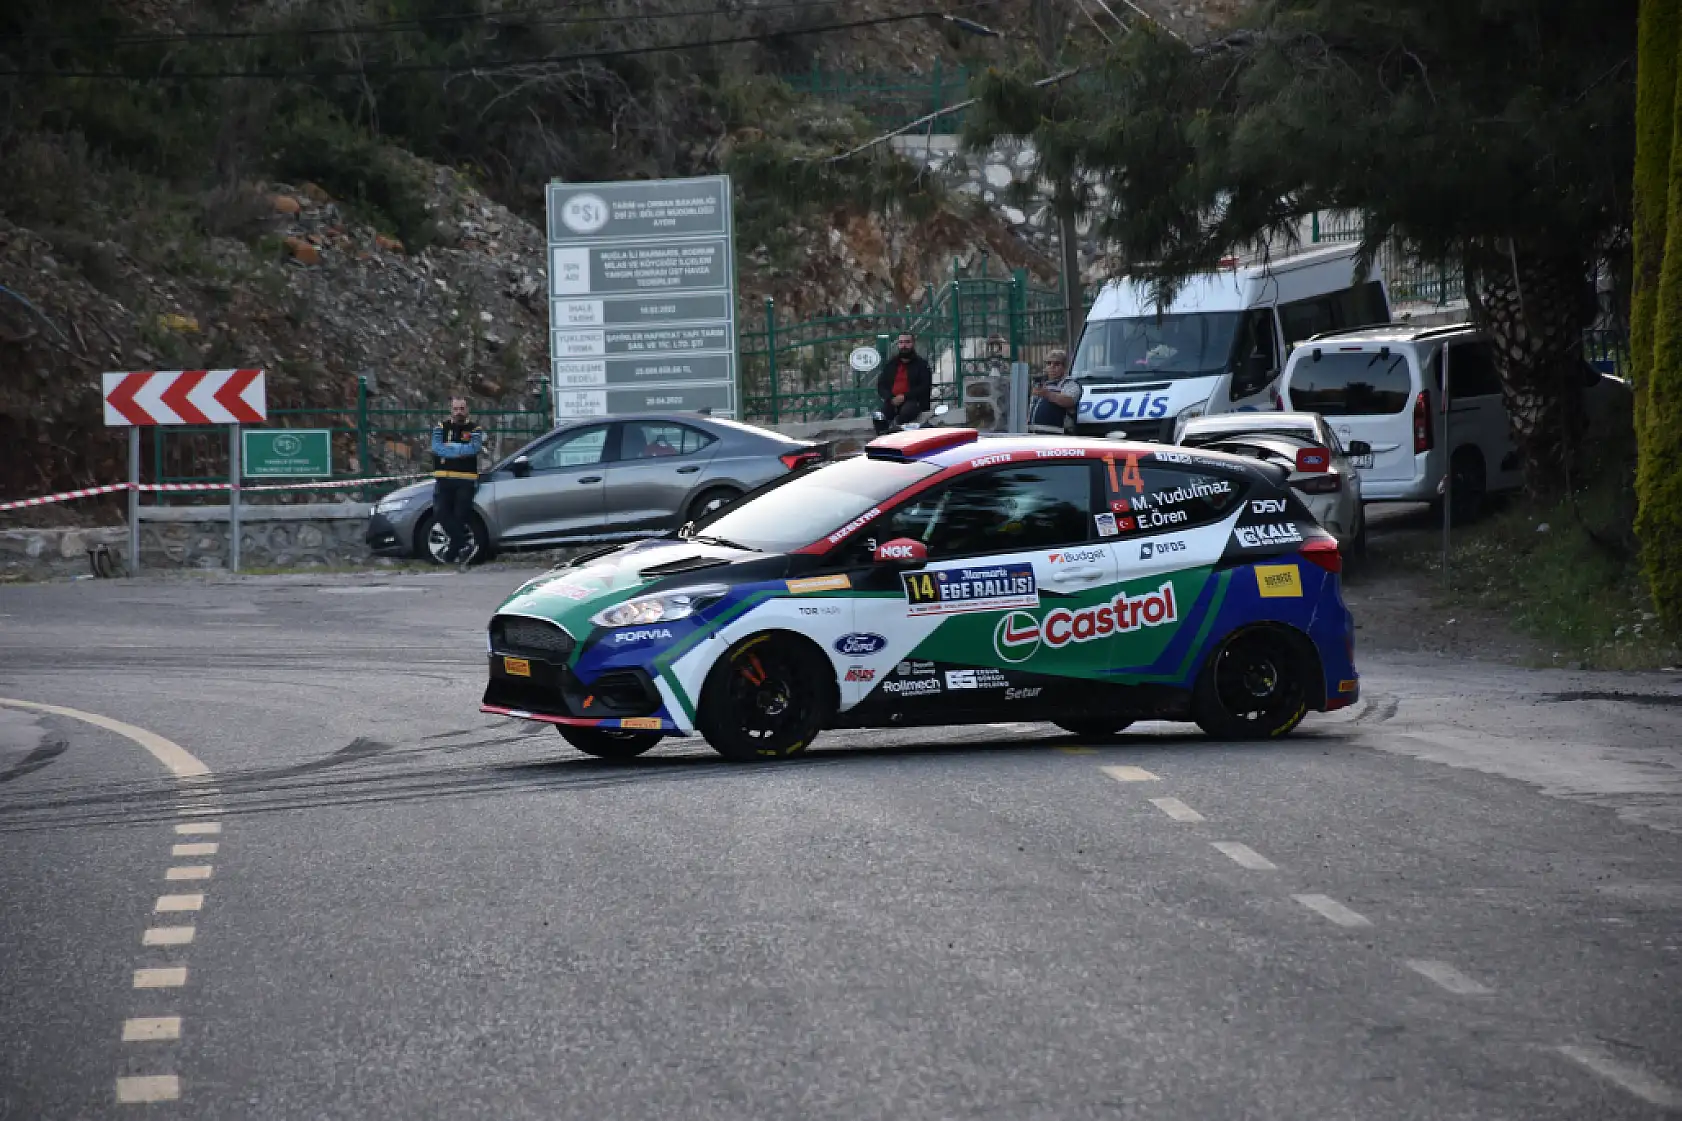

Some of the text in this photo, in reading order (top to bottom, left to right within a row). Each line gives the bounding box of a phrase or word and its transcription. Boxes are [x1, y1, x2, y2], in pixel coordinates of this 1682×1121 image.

[1078, 392, 1169, 420] POLİS
[1035, 448, 1085, 458] TEROSON
[1101, 451, 1145, 493] 14
[1131, 481, 1232, 511] M. Yudulmaz
[1251, 498, 1287, 514] DSV
[1255, 522, 1301, 540] KALE
[880, 545, 913, 558] NGK
[1155, 541, 1187, 554] DFDS
[1063, 549, 1106, 563] Budget
[908, 574, 935, 600] 14
[940, 582, 970, 599] EGE
[1044, 585, 1176, 646] Castrol
[615, 629, 672, 643] FORVIA
[883, 678, 941, 693] Rollmech
[1004, 687, 1043, 700] Setur
